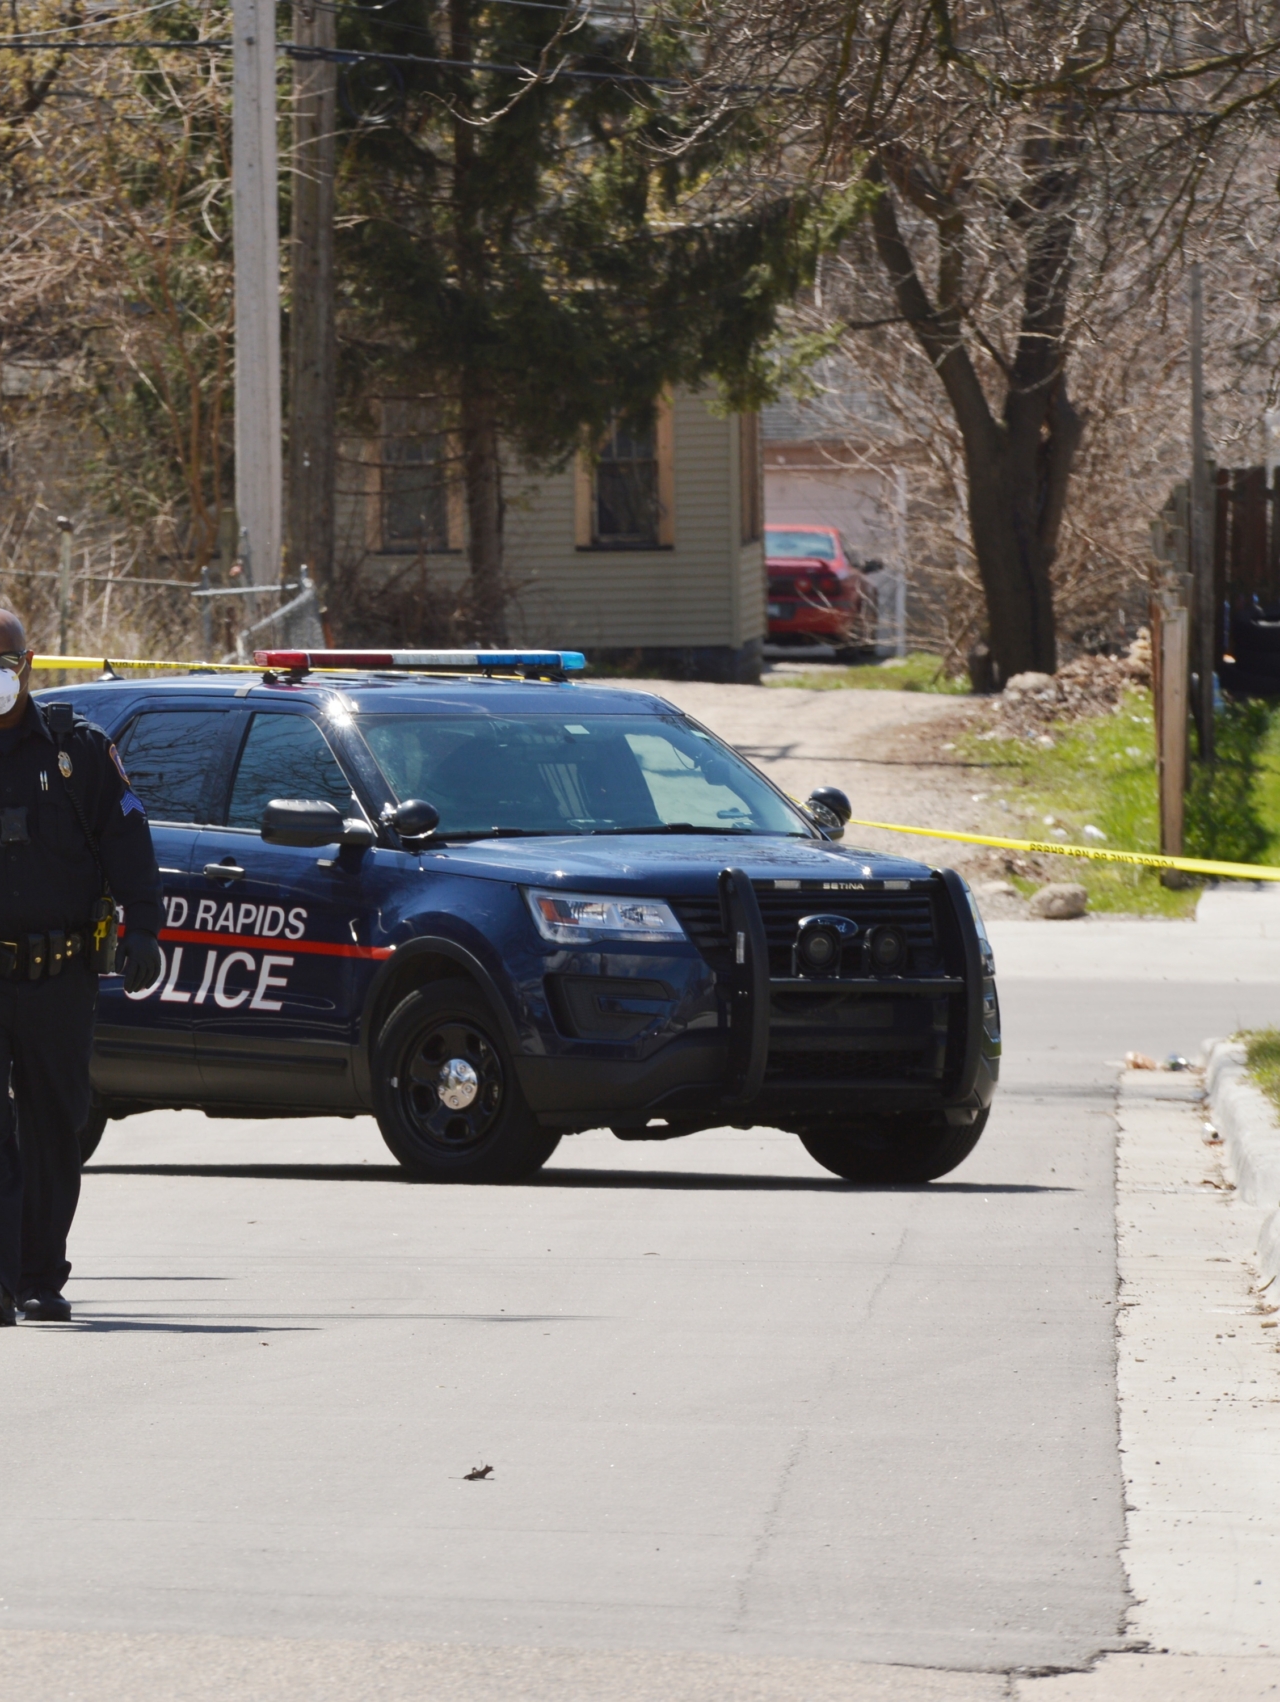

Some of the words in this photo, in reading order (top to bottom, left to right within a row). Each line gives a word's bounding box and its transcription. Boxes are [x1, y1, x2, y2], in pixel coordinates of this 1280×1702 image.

[823, 882, 865, 891] SETINA
[195, 898, 308, 940] RAPIDS
[123, 946, 295, 1011] OLICE
